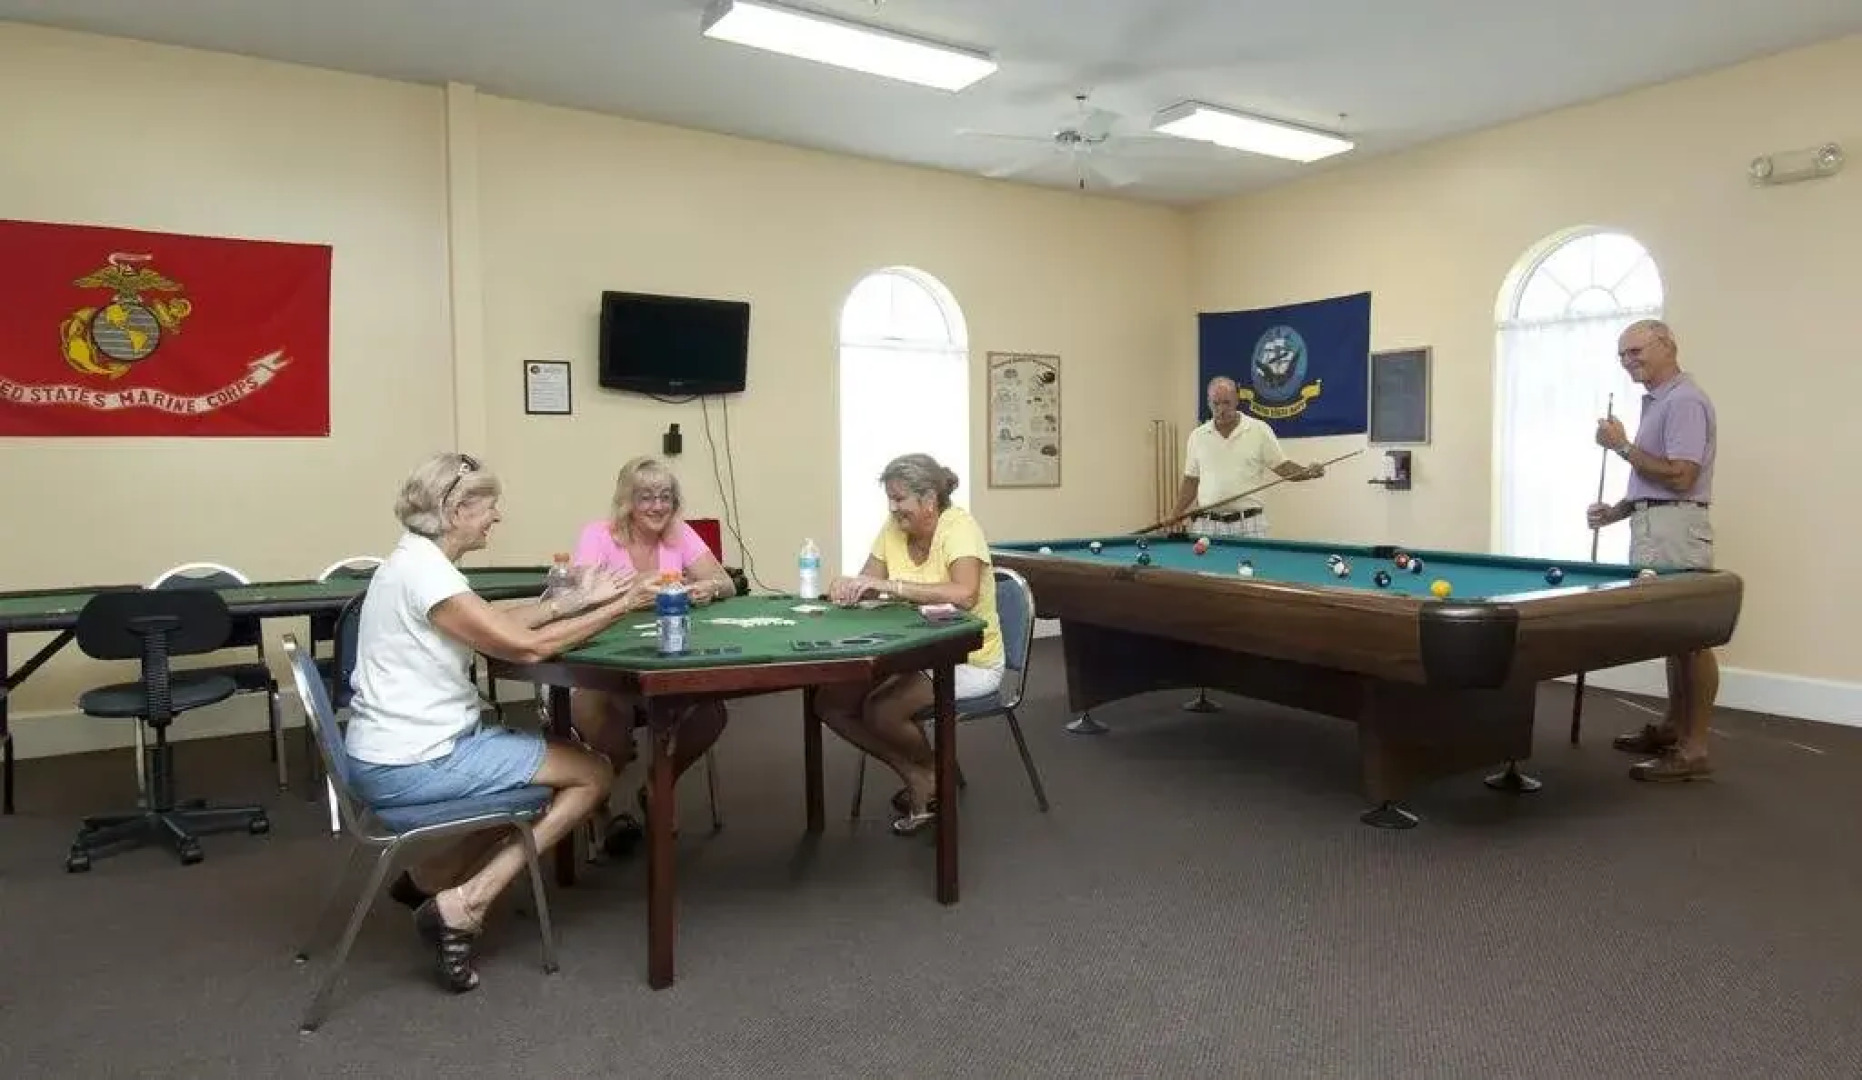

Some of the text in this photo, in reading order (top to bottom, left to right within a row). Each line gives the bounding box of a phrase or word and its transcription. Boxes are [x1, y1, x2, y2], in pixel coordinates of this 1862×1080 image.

[30, 387, 105, 408] STATES
[119, 390, 196, 412] MARINE
[206, 377, 259, 408] CORPS
